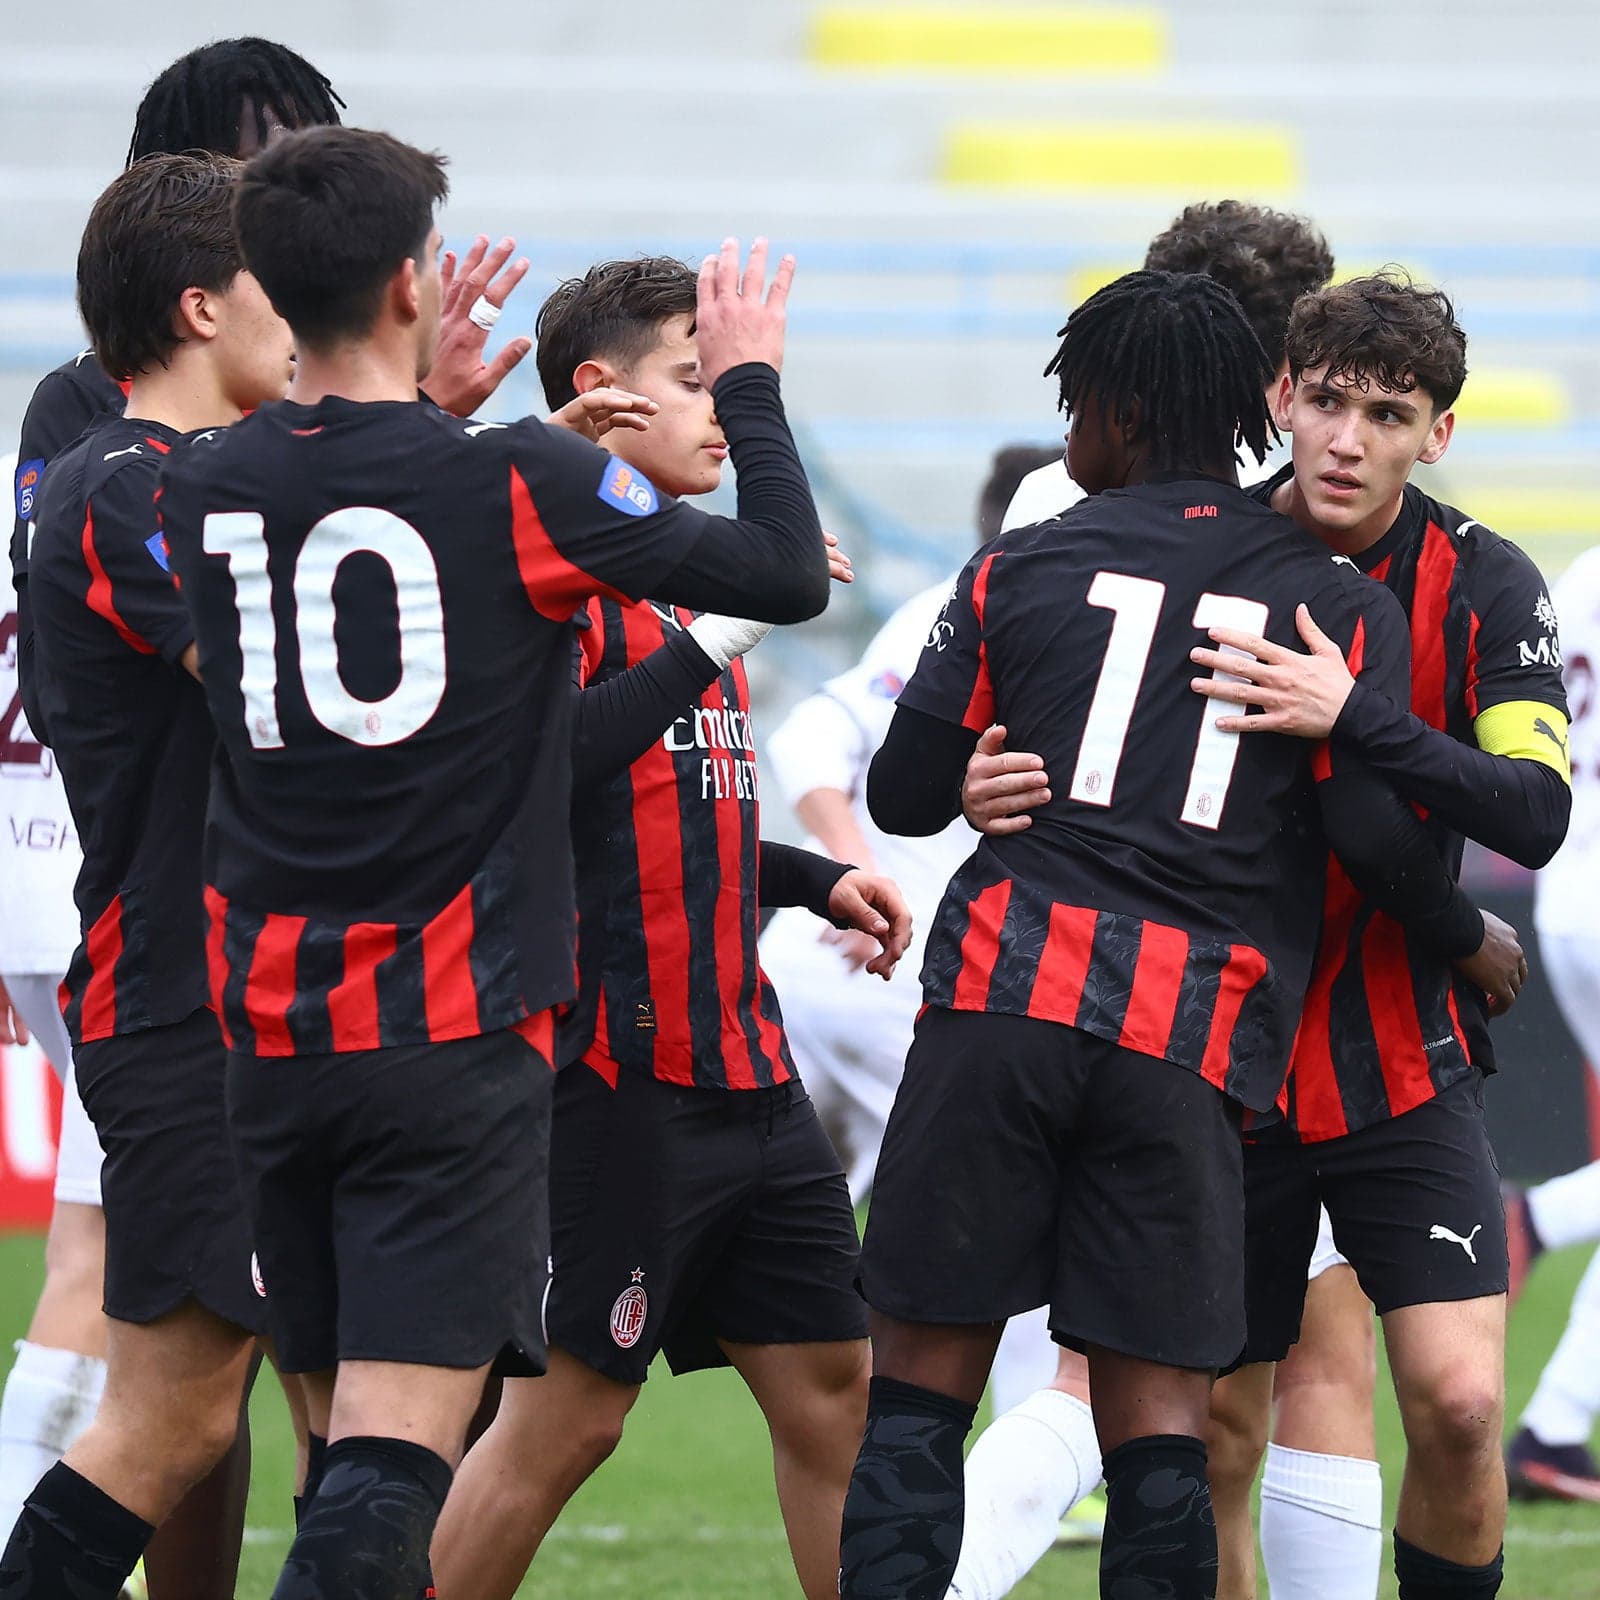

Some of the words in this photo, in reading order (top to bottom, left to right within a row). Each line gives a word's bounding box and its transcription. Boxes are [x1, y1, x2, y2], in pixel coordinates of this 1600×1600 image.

[1184, 504, 1218, 520] MILAN
[202, 505, 448, 750] 10
[1068, 570, 1271, 832] 11
[701, 758, 731, 800] FLY
